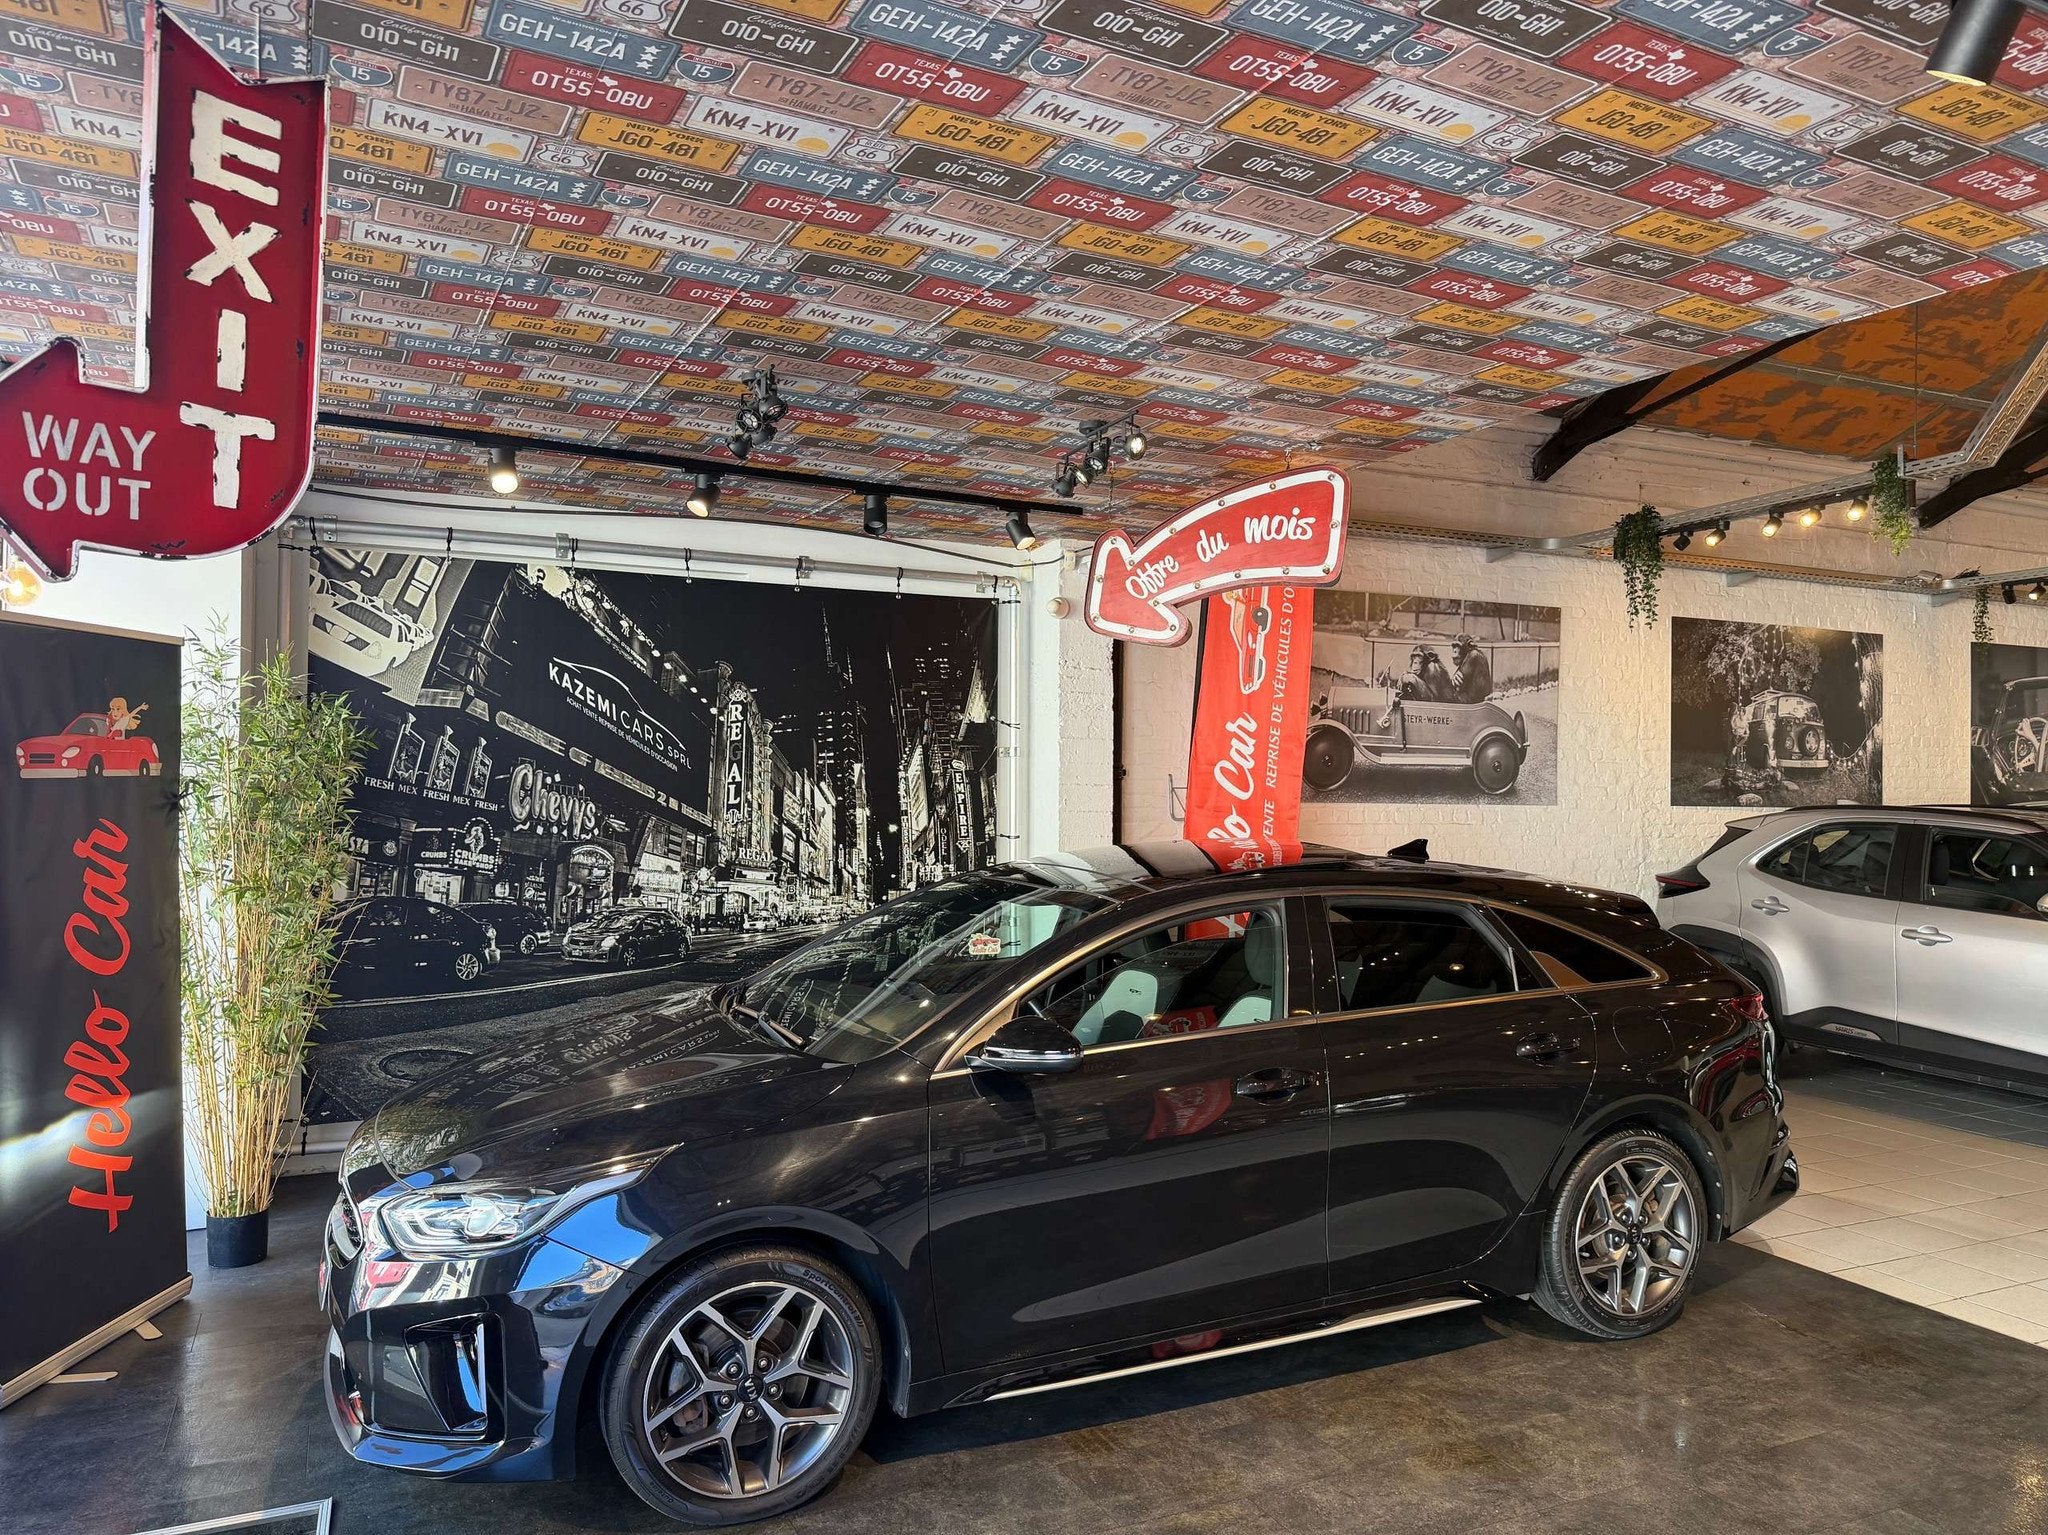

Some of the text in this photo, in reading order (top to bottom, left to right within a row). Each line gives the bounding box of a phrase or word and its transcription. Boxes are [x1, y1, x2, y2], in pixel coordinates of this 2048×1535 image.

[746, 15, 806, 35] California
[869, 3, 989, 52] GEH-142A
[1122, 6, 1179, 27] California
[380, 20, 444, 39] California
[499, 13, 622, 60] GEH-142A
[1401, 44, 1436, 60] 15
[1640, 40, 1675, 52] TEXAS
[1772, 34, 1813, 50] 15
[912, 58, 944, 70] TEXAS
[1040, 54, 1070, 70] 15
[1270, 49, 1303, 61] TEXAS
[19, 73, 41, 88] 15
[350, 65, 371, 80] 15
[564, 67, 594, 78] TEXAS
[690, 63, 715, 78] 15
[947, 115, 1025, 136] NEW YORK
[1279, 108, 1353, 130] NEW YORK
[624, 122, 705, 143] NEW YORK
[1489, 136, 1518, 147] 66
[854, 150, 879, 159] 66
[1167, 144, 1194, 154] 66
[1058, 153, 1154, 185] GEH-142A
[1371, 146, 1465, 179] GEH-142A
[455, 162, 557, 193] GEH-142A
[753, 158, 851, 190] GEH-142A
[426, 264, 513, 286] GEH-142A
[675, 261, 759, 284] GEH-142A
[929, 259, 1011, 282] GEH-142A
[1189, 256, 1269, 280] GEH-142A
[179, 89, 282, 509] EXIT
[22, 411, 156, 471] WAY
[22, 468, 151, 520] OUT
[1196, 529, 1230, 563] du
[1243, 507, 1317, 544] mois
[1273, 619, 1292, 702] VÉHICULES
[549, 663, 692, 769] KAZEMI CARS SPRL
[567, 697, 582, 711] ACHAT
[583, 706, 598, 722] VENTE
[1271, 704, 1283, 723] DE
[727, 703, 743, 812] REGAL
[1213, 710, 1259, 801] Car
[1266, 726, 1281, 789] REPRISE
[364, 776, 498, 811] FRESH MEX FRESH MEX FRESH
[509, 763, 596, 840] Chevys
[954, 772, 969, 837] EMPIRE
[421, 851, 447, 859] CRUMBS
[455, 849, 495, 864] CRUMBS
[64, 818, 134, 1234] Hello Car
